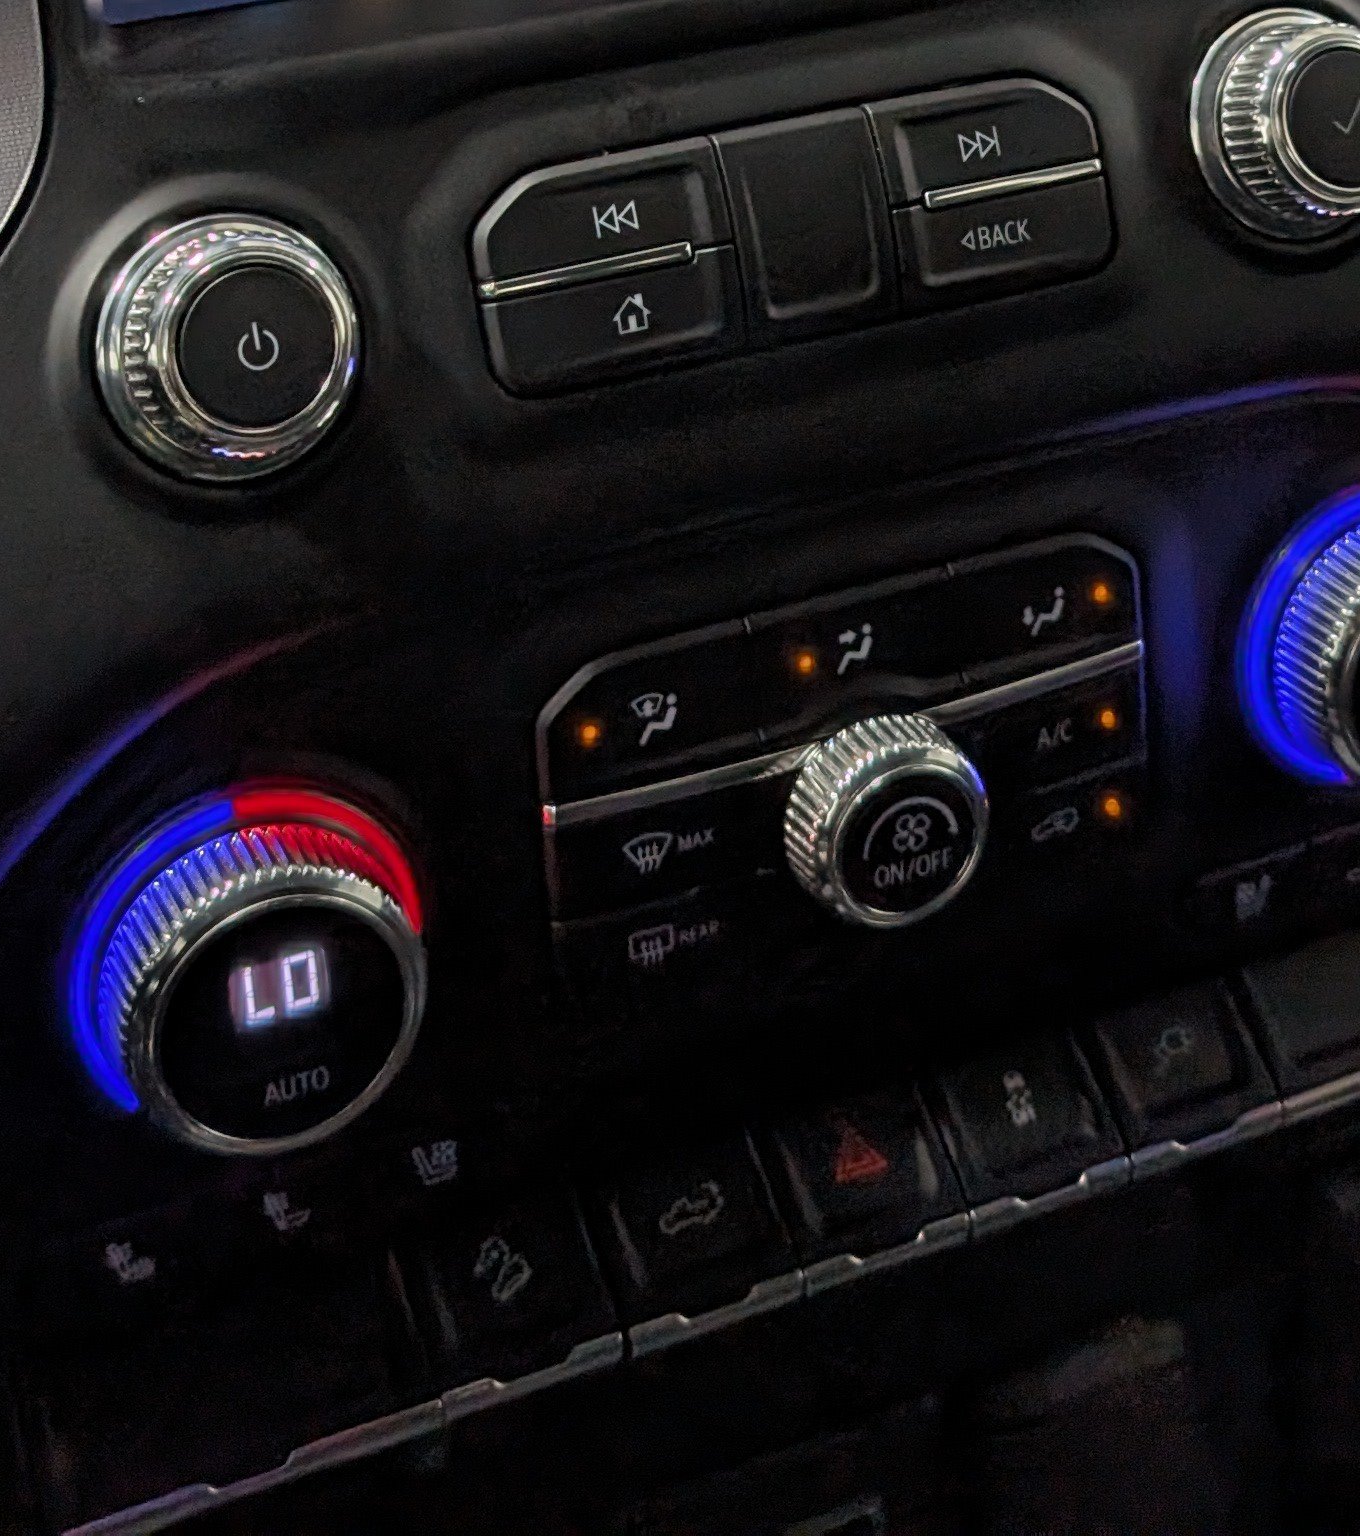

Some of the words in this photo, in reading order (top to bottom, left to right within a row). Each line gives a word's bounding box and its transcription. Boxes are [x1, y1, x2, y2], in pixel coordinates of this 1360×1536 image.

[1037, 717, 1073, 749] A/C
[676, 827, 715, 853] MAX
[872, 848, 953, 888] ON/OFF
[243, 950, 321, 1026] LO
[263, 1066, 330, 1107] AUTO
